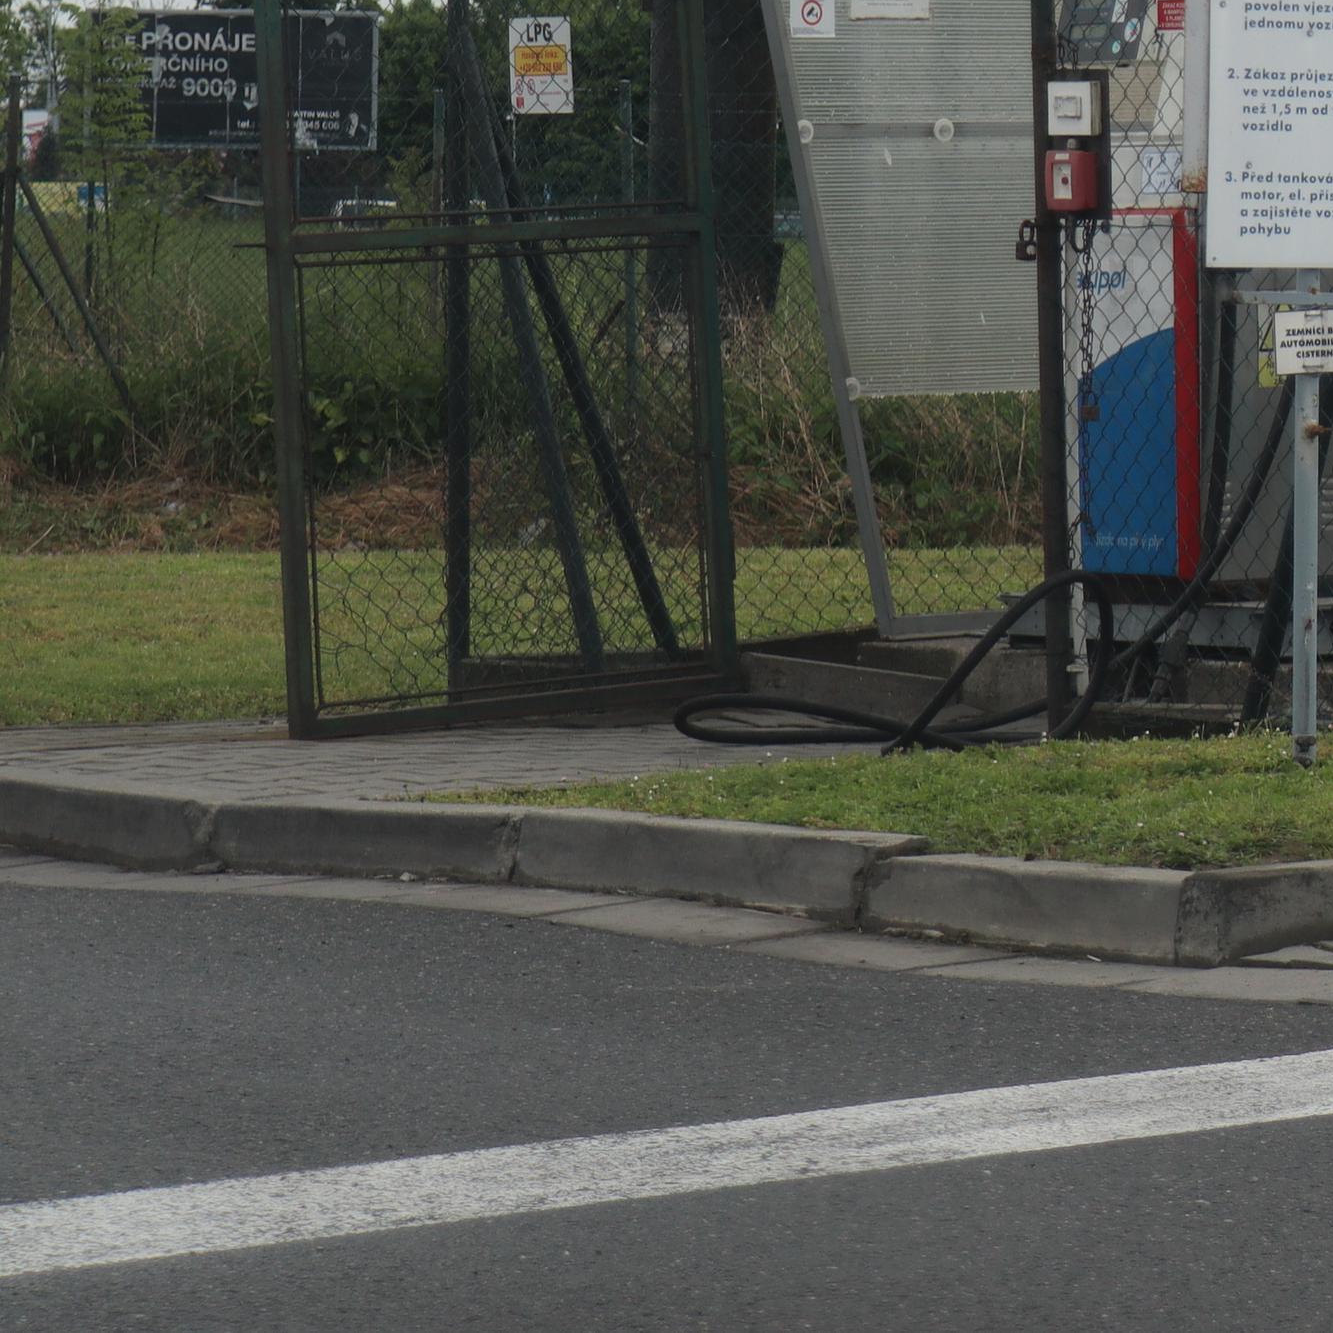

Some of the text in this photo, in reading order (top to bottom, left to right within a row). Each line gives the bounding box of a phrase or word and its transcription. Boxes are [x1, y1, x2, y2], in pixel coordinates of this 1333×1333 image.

[1245, 0, 1300, 13] povolen
[1244, 17, 1304, 31] jednomu
[141, 27, 256, 52] PRONÁJE
[526, 23, 553, 43] LPG
[1227, 68, 1240, 80] 2.
[1244, 68, 1286, 80] Zákaz
[1243, 88, 1258, 97] ve
[1243, 103, 1267, 114] než
[1271, 104, 1292, 116] 1,5
[1296, 106, 1308, 115] m
[1312, 104, 1329, 116] od
[1242, 120, 1293, 132] vozidla
[1225, 172, 1238, 183] 3.
[1241, 171, 1274, 183] Před
[1240, 190, 1285, 203] motor,
[1289, 190, 1306, 202] el.
[1240, 208, 1249, 218] a
[1252, 206, 1312, 221] zajistěte
[1239, 224, 1291, 237] pohybu
